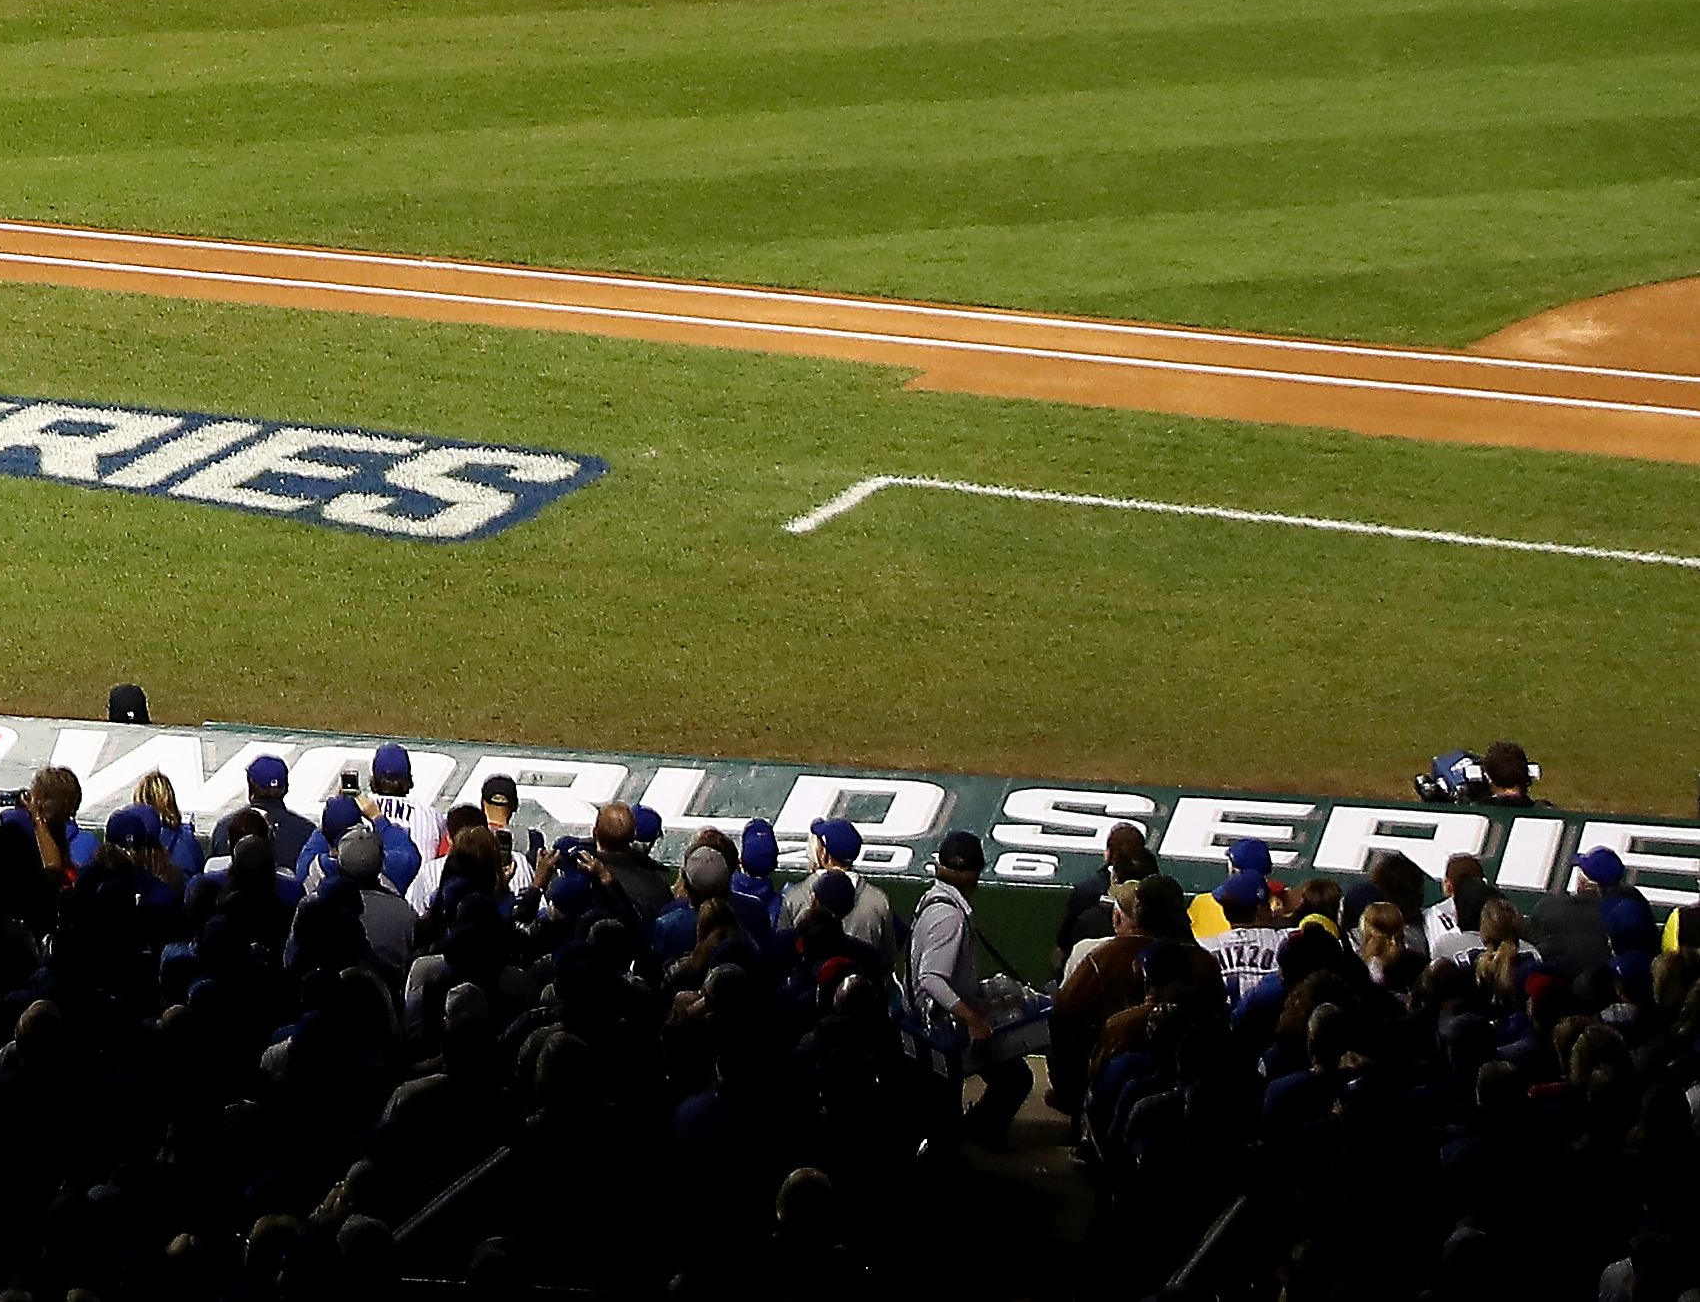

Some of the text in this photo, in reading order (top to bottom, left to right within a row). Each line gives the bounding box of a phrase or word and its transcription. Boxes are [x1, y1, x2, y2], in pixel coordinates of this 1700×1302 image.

[50, 726, 943, 843] WORLD
[376, 798, 415, 822] YANT
[773, 838, 1062, 880] 206
